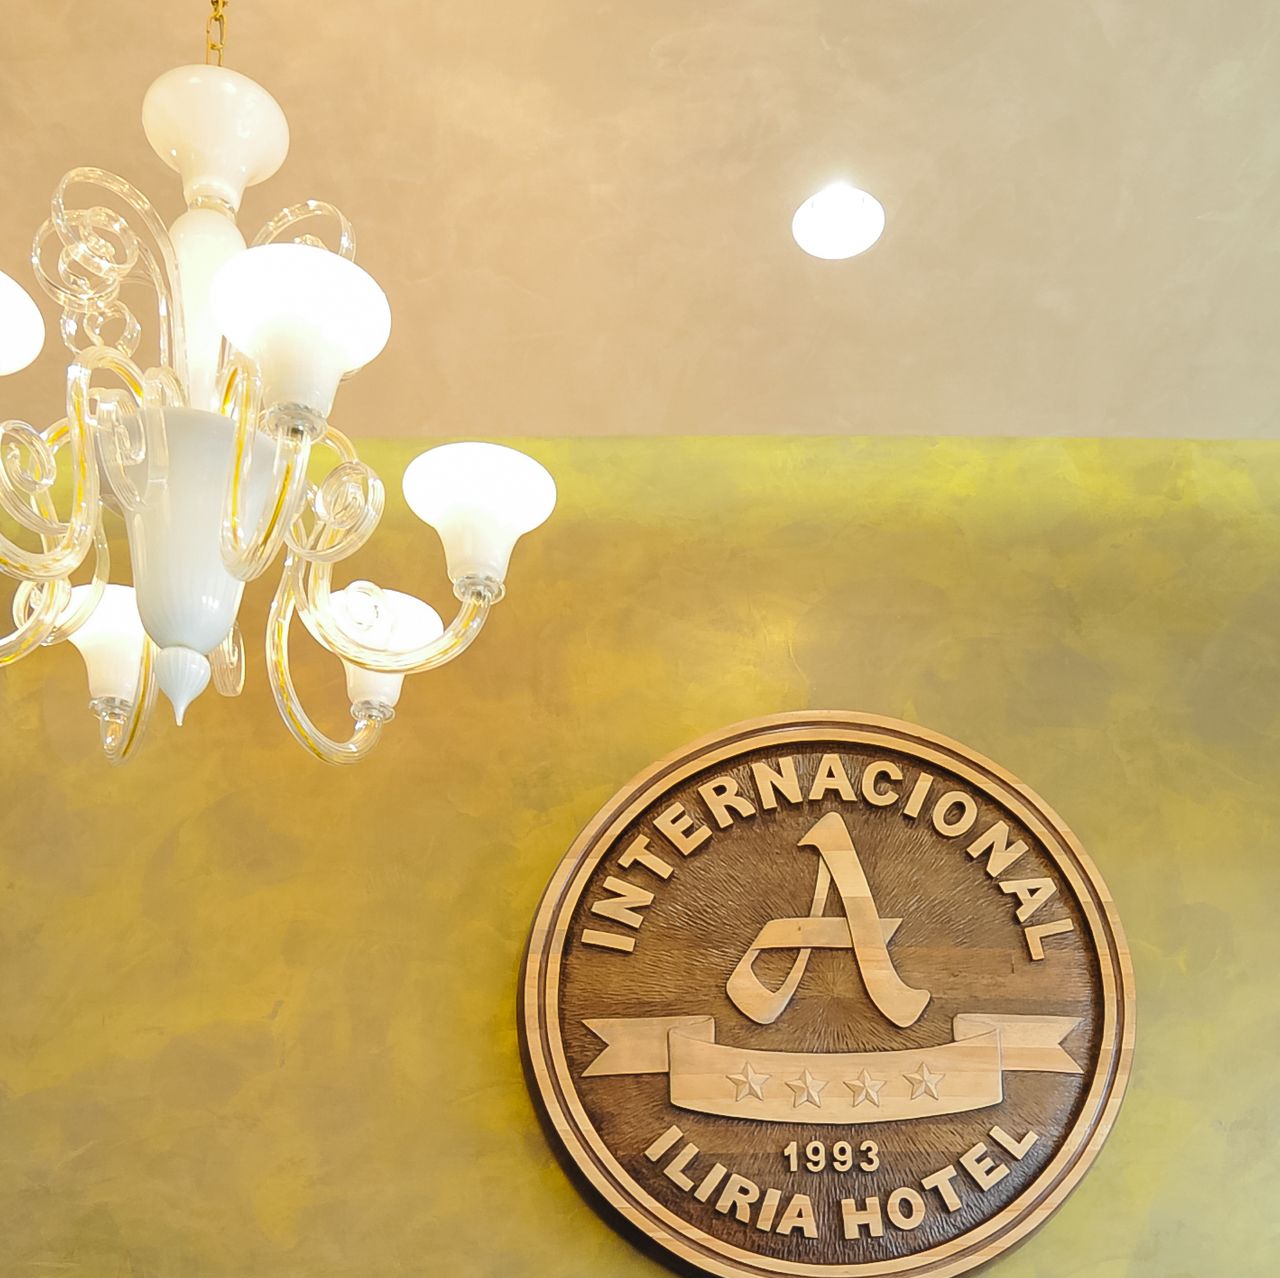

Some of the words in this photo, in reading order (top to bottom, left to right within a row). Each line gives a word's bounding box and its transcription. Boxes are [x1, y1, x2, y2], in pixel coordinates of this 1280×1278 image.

[580, 753, 1075, 962] INTERNACIONAL
[725, 811, 931, 1029] A
[644, 1125, 819, 1240] ILIRIA
[841, 1125, 1039, 1241] HOTEL
[783, 1141, 881, 1174] 1993
